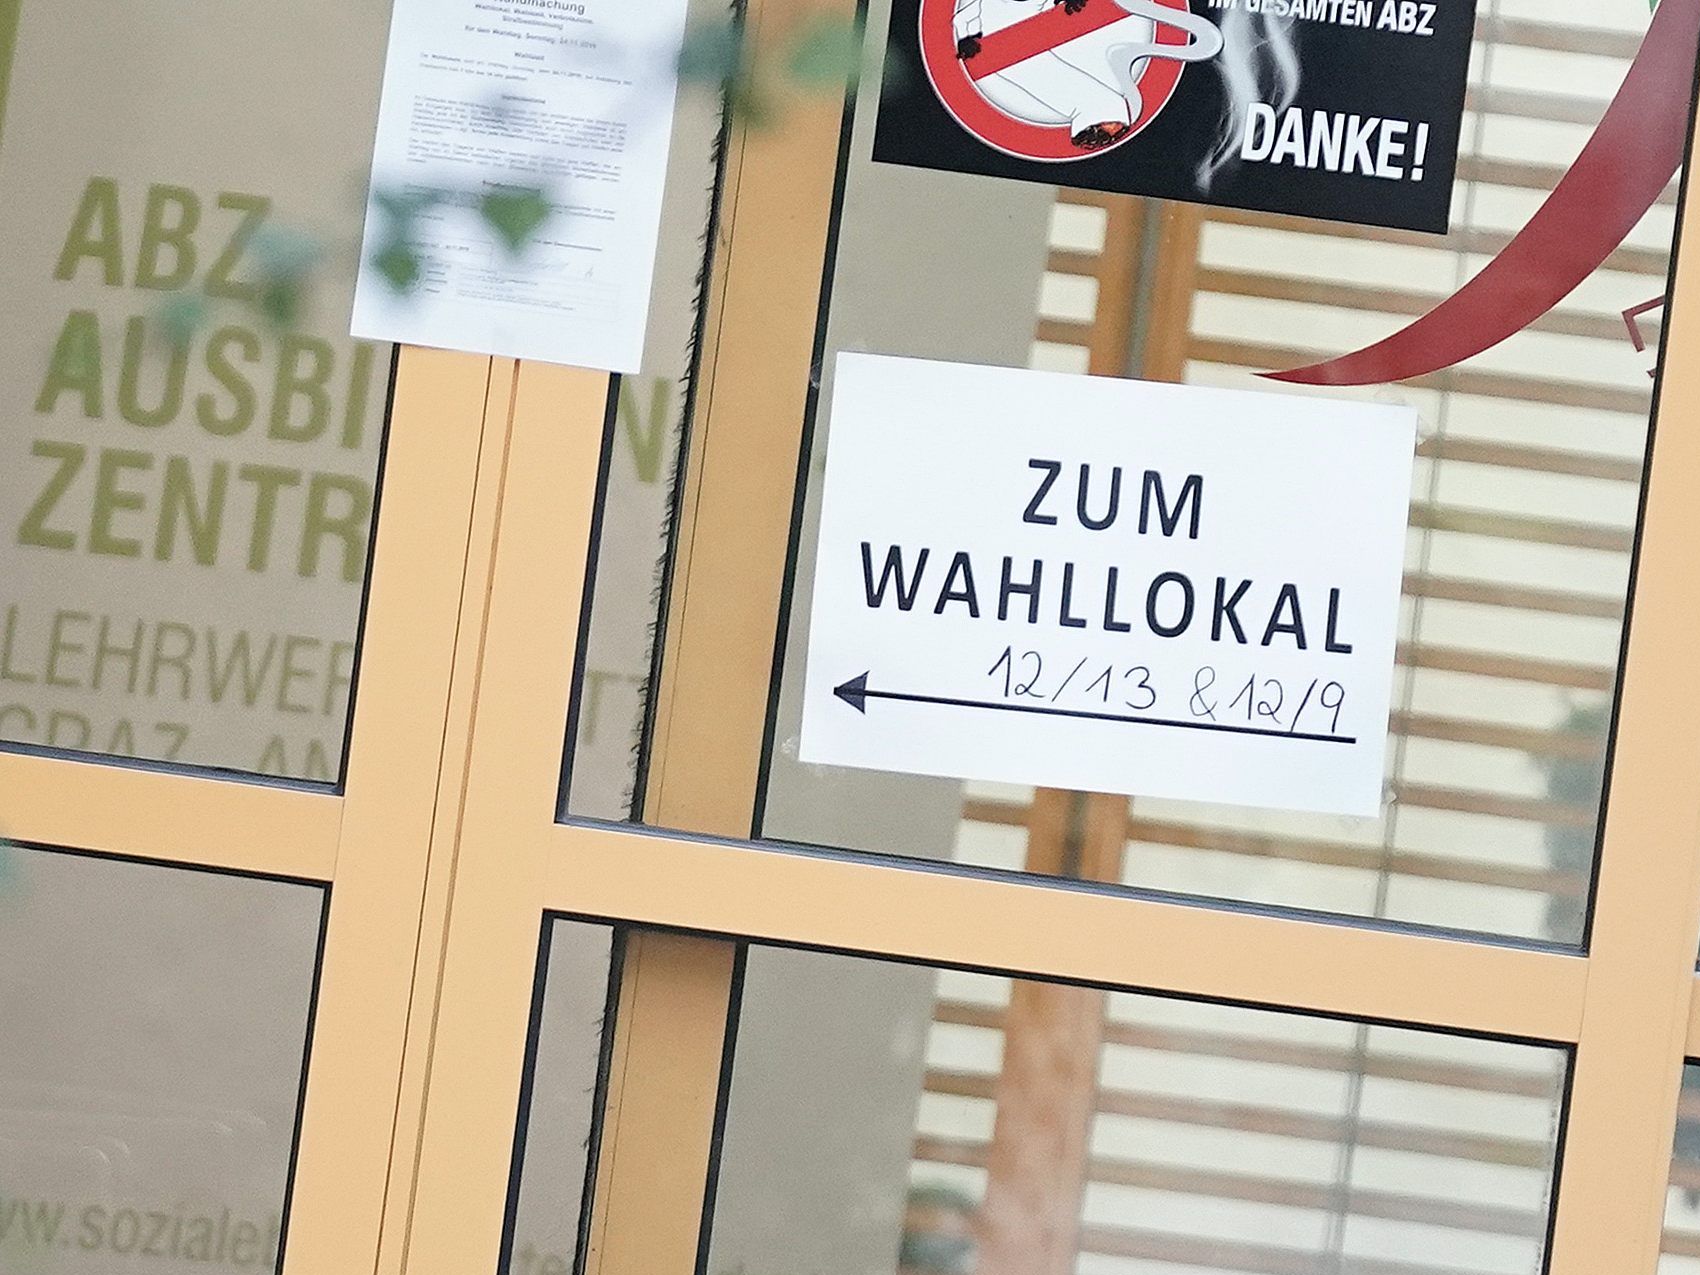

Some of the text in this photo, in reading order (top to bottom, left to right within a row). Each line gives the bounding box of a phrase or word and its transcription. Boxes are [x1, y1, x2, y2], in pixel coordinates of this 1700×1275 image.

[1376, 0, 1438, 36] ABZ
[1240, 102, 1430, 182] DANKE!
[52, 175, 271, 301] ABZ
[1022, 458, 1204, 539] ZUM
[860, 541, 1354, 654] WAHLLOKAL
[987, 645, 1157, 710] 12/13
